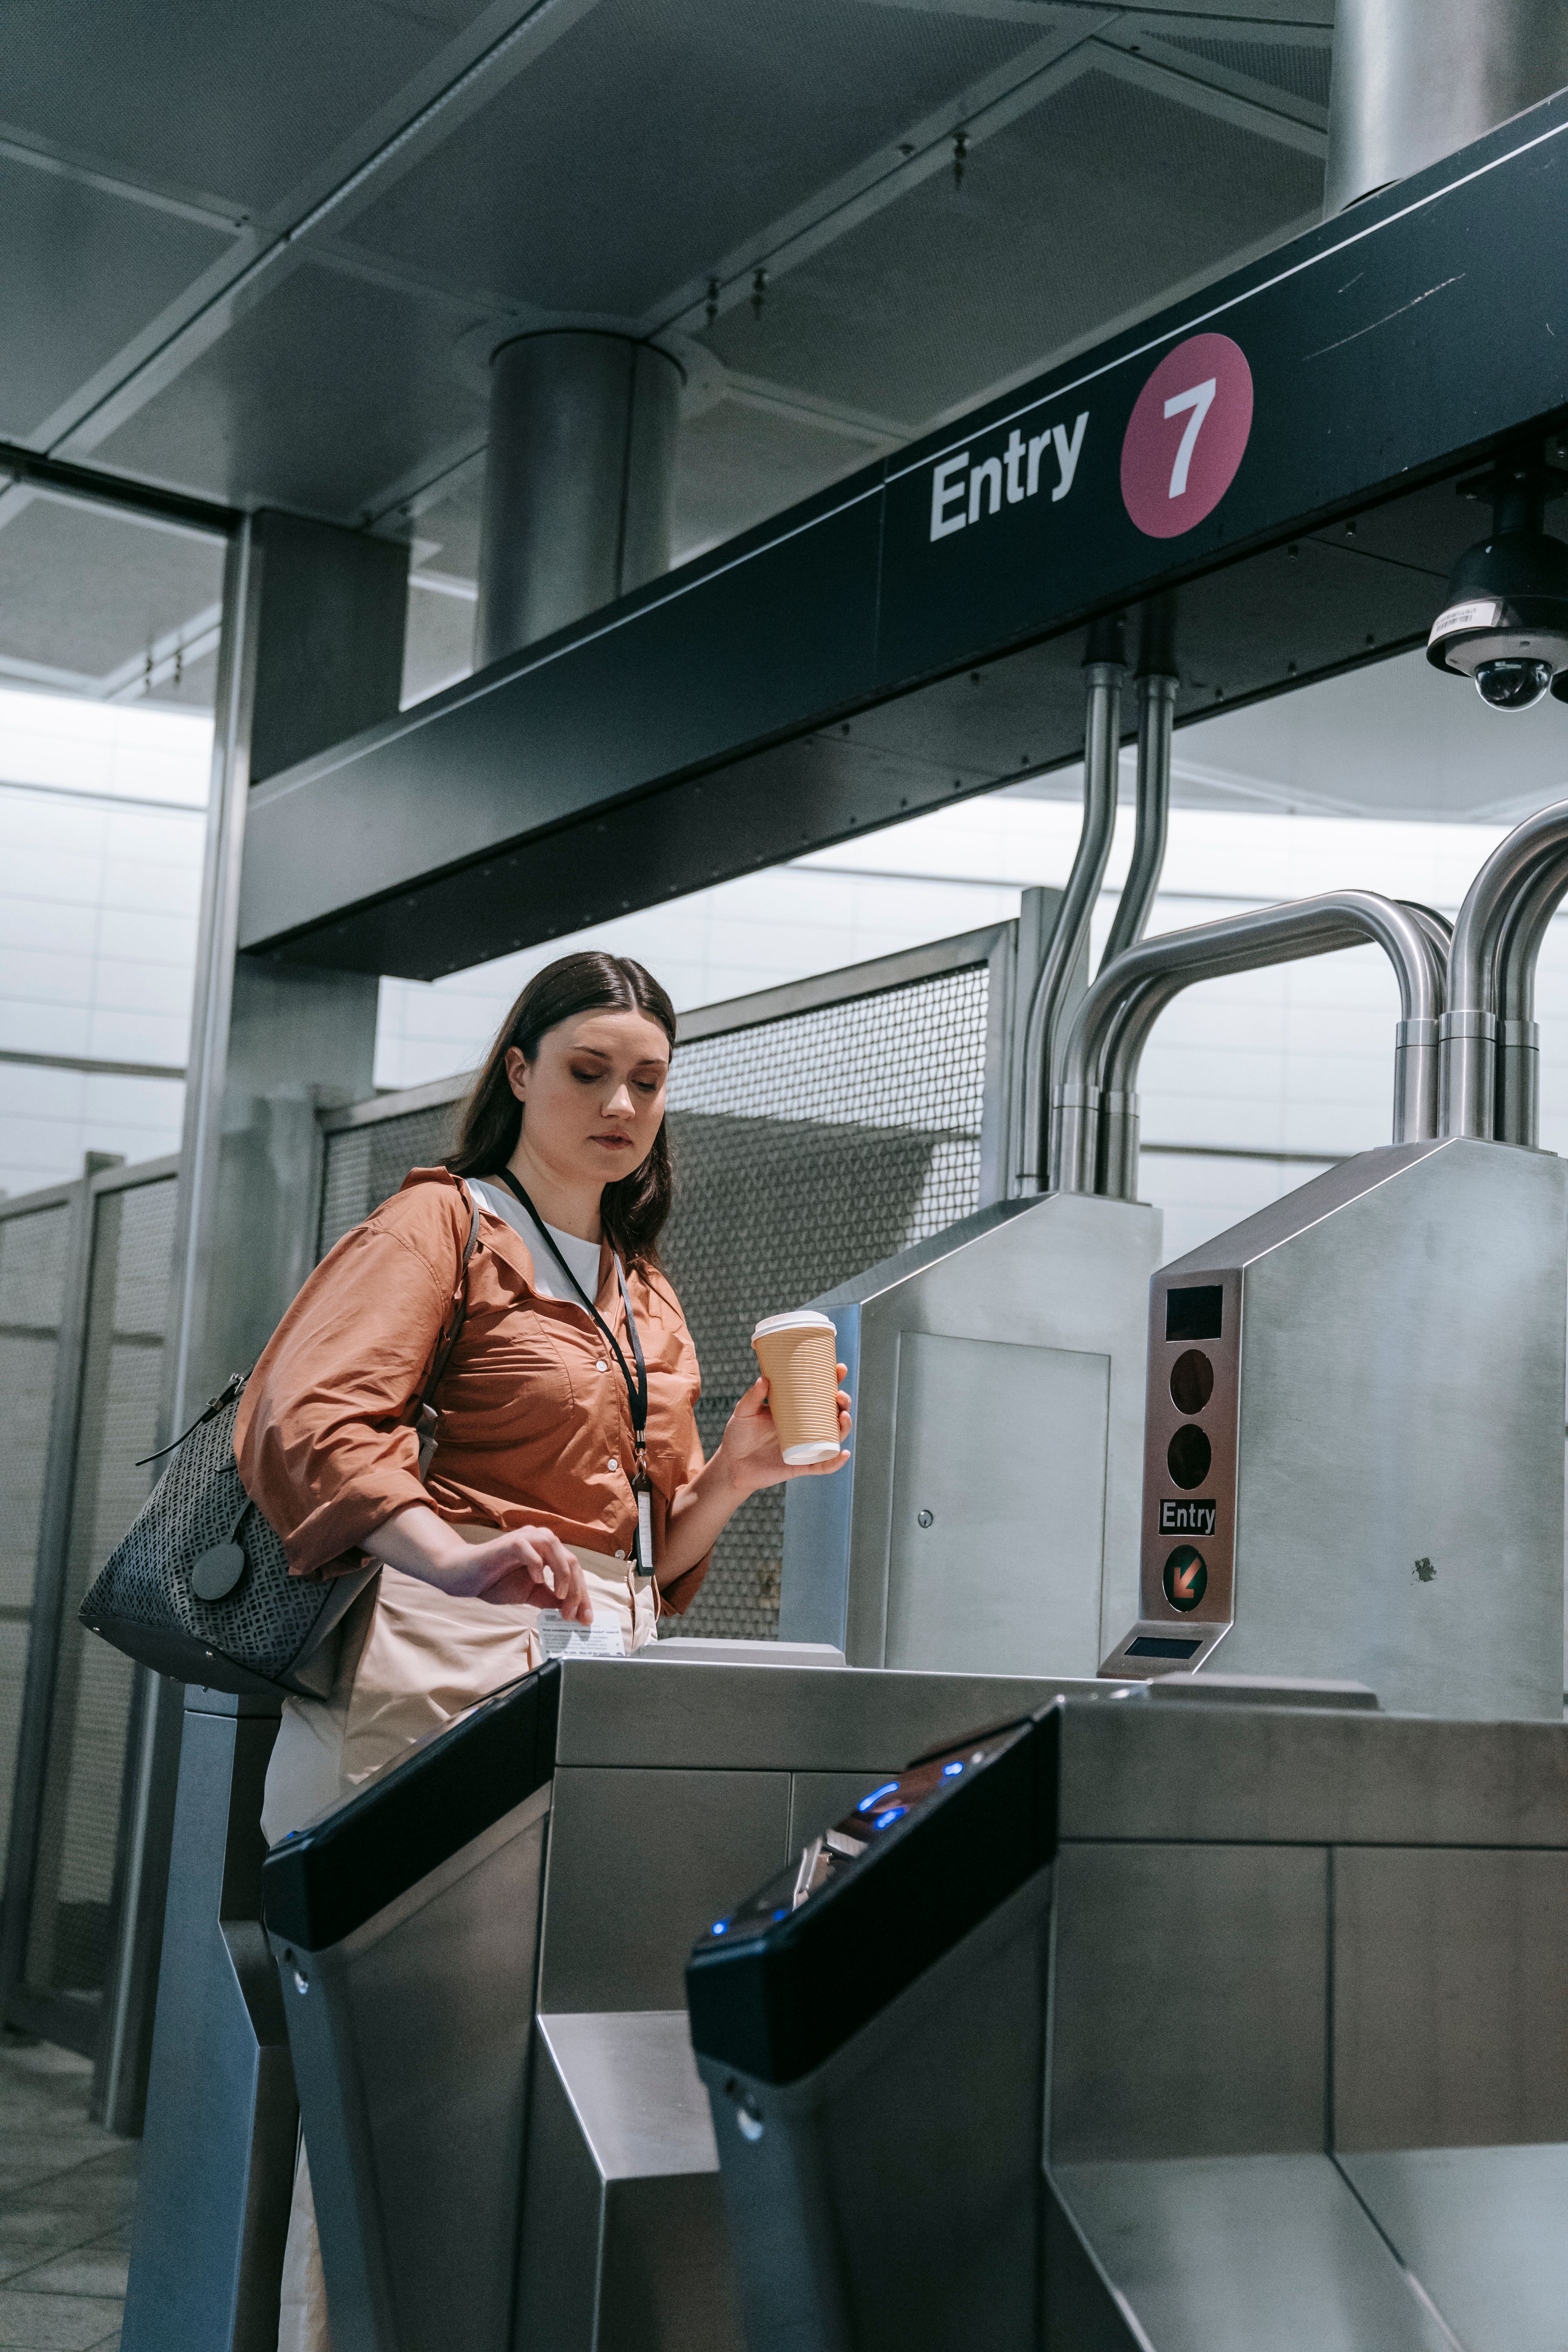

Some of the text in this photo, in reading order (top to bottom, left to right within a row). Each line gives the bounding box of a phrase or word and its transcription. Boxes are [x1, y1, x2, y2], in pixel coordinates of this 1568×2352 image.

[930, 378, 1216, 543] Entry 7
[1163, 1502, 1216, 1534] Entry
